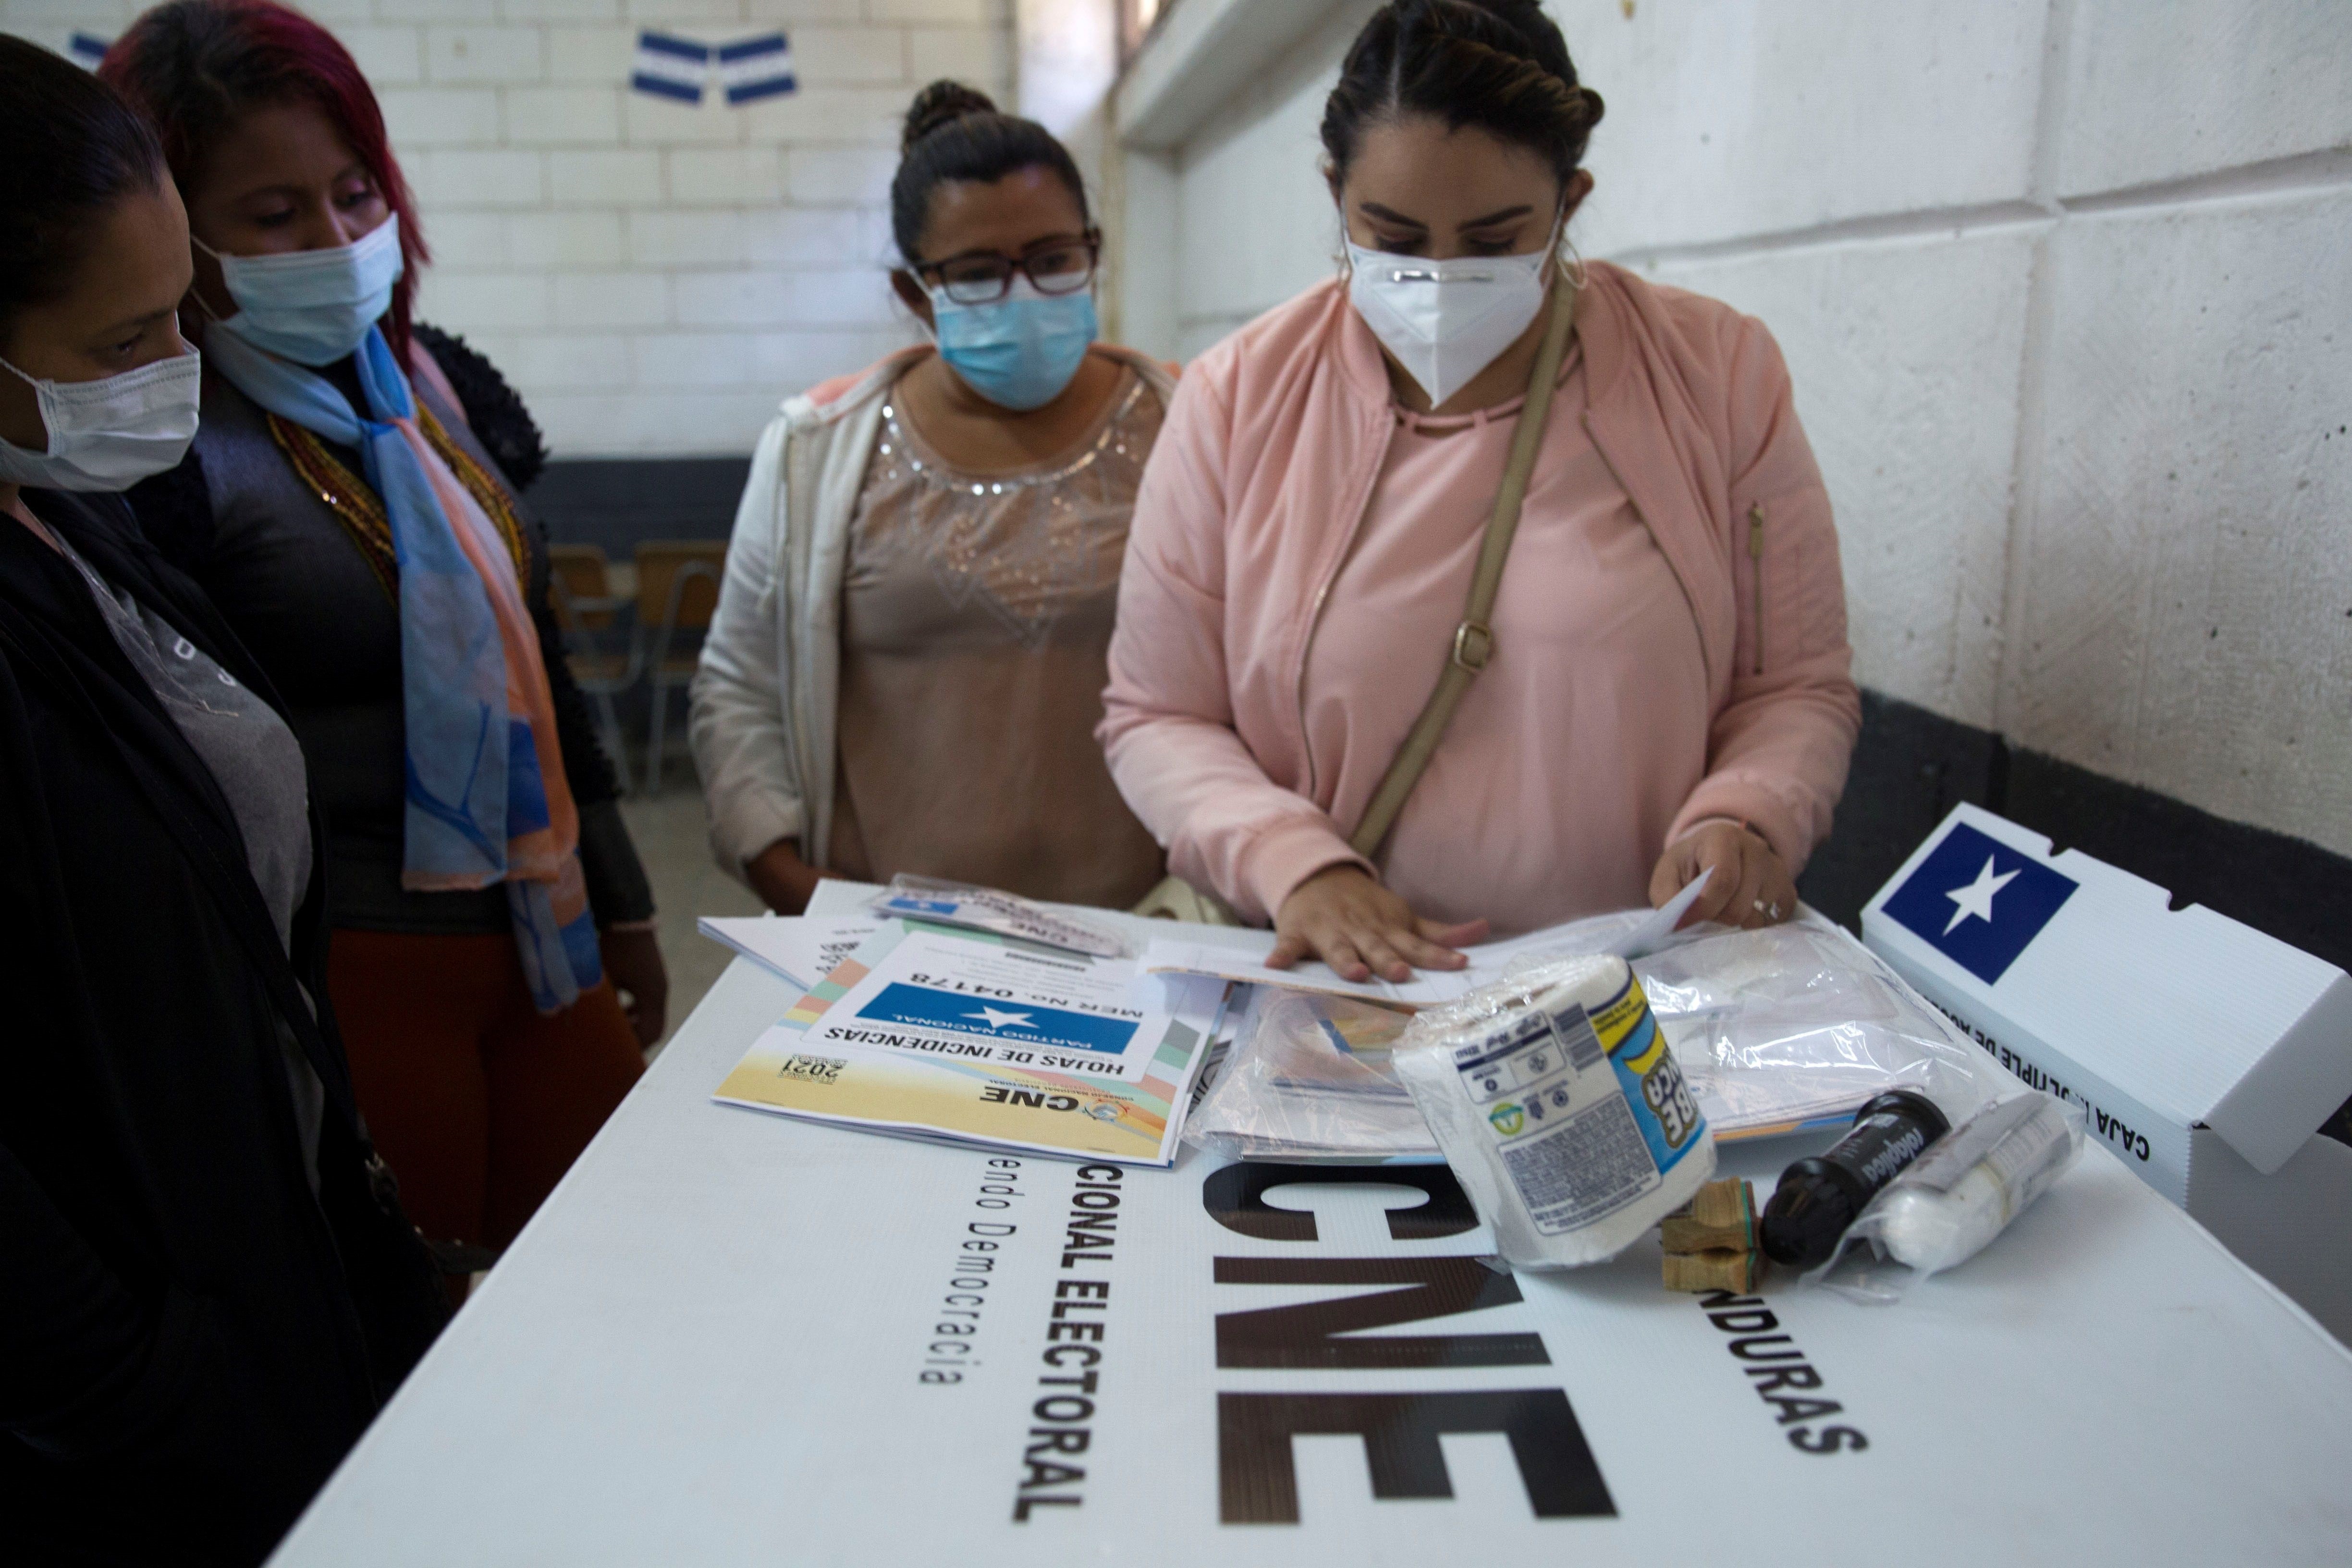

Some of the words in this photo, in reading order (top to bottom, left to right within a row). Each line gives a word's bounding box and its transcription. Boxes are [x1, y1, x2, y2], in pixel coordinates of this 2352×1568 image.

[910, 973, 1014, 998] 04178
[1024, 992, 1069, 1007] No.
[1078, 1002, 1143, 1018] MER
[892, 1013, 998, 1035] NACIONAL
[824, 1026, 993, 1058] INCIDENCIAS
[1002, 1029, 1093, 1050] PARTIDO
[783, 1058, 844, 1077] 2021
[997, 1049, 1036, 1065] DE
[1039, 1054, 1126, 1076] HOJAS
[980, 1086, 1080, 1112] CNE
[2095, 1106, 2150, 1162] CAJA
[1061, 1164, 1124, 1268] CIONAL
[918, 1222, 1017, 1385] Democracia
[1202, 1162, 1619, 1526] CNE
[1011, 1280, 1110, 1524] ELECTORAL
